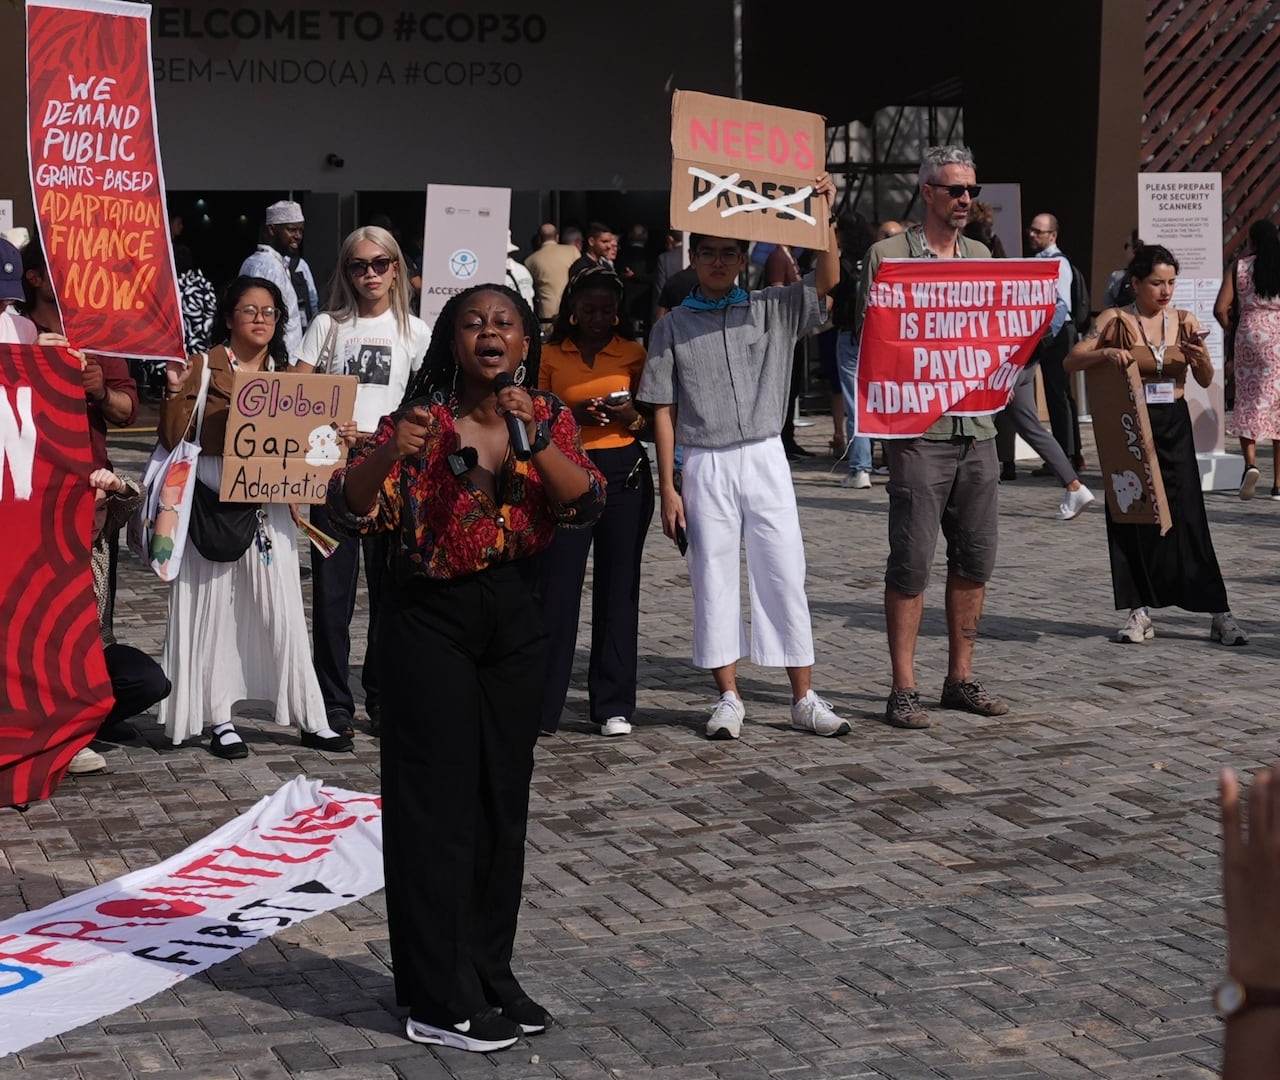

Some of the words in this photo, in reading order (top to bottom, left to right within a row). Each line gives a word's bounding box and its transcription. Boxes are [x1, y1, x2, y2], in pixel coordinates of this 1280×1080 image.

[158, 8, 320, 41] ELCOME
[329, 10, 383, 41] TO
[394, 11, 547, 44] #COP30
[67, 74, 116, 101] WE
[377, 61, 395, 85] A
[405, 61, 522, 86] #COP30
[45, 100, 141, 130] DEMAND
[43, 128, 135, 164] PUBLIC
[690, 116, 815, 171] NEEDS
[36, 163, 153, 192] GRANTS-BASED
[1146, 183, 1176, 191] PLEASE
[1178, 183, 1215, 191] PREPARE
[40, 189, 161, 229] ADAPTATION
[1151, 193, 1168, 201] FOR
[1170, 193, 1209, 201] SECURITY
[51, 224, 155, 261] FINANCE
[64, 262, 156, 311] NOW!
[911, 280, 996, 308] WITHOUT
[900, 312, 919, 339] IS
[925, 310, 989, 338] EMPTY
[237, 378, 340, 417] Global
[233, 423, 300, 469] Gap
[1121, 413, 1142, 461] GAP
[228, 466, 327, 500] Adaptatio
